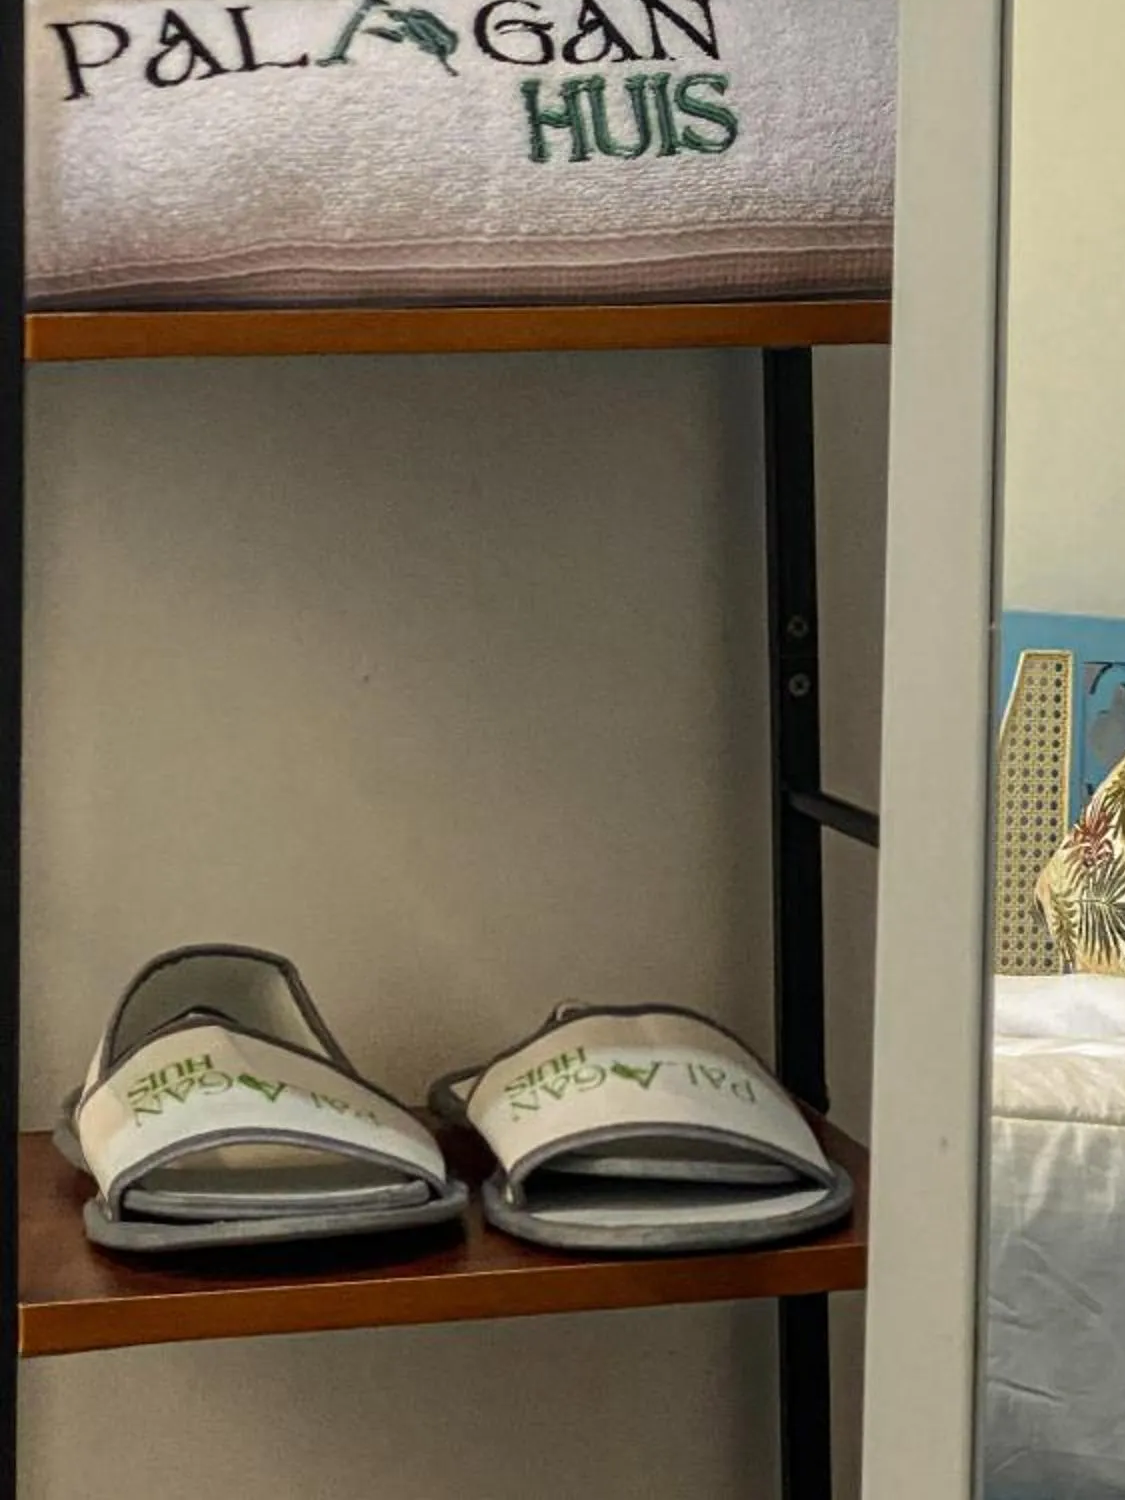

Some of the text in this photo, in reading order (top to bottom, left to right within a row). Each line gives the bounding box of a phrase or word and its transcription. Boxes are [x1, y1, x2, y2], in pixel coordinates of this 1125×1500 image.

[519, 72, 739, 163] HUIS
[126, 1053, 214, 1098] HUIS
[504, 1046, 588, 1098] HUIS
